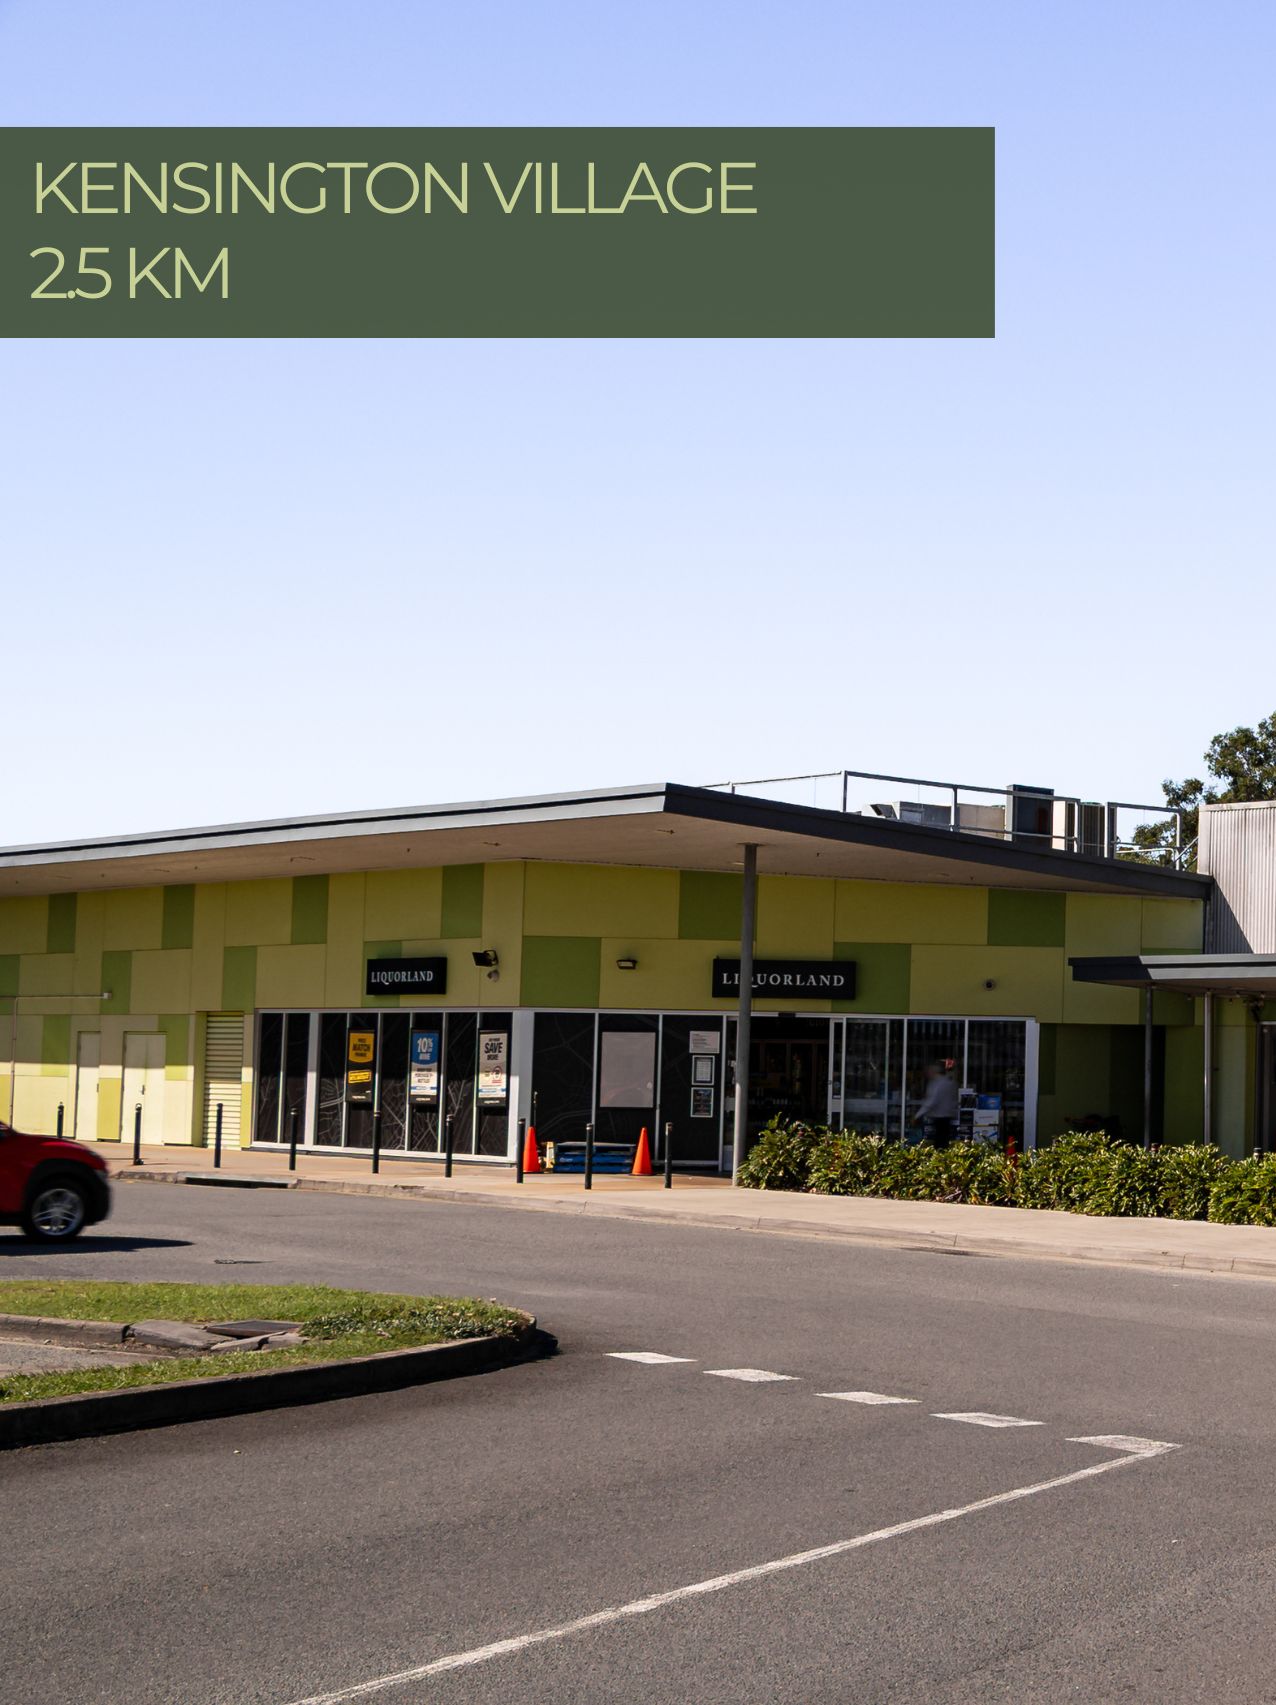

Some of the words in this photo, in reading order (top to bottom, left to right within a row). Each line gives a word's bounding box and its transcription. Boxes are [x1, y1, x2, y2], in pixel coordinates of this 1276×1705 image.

[371, 970, 434, 985] LIQUORLAND
[722, 973, 845, 988] LIUORLAND
[484, 1042, 503, 1054] SAVE
